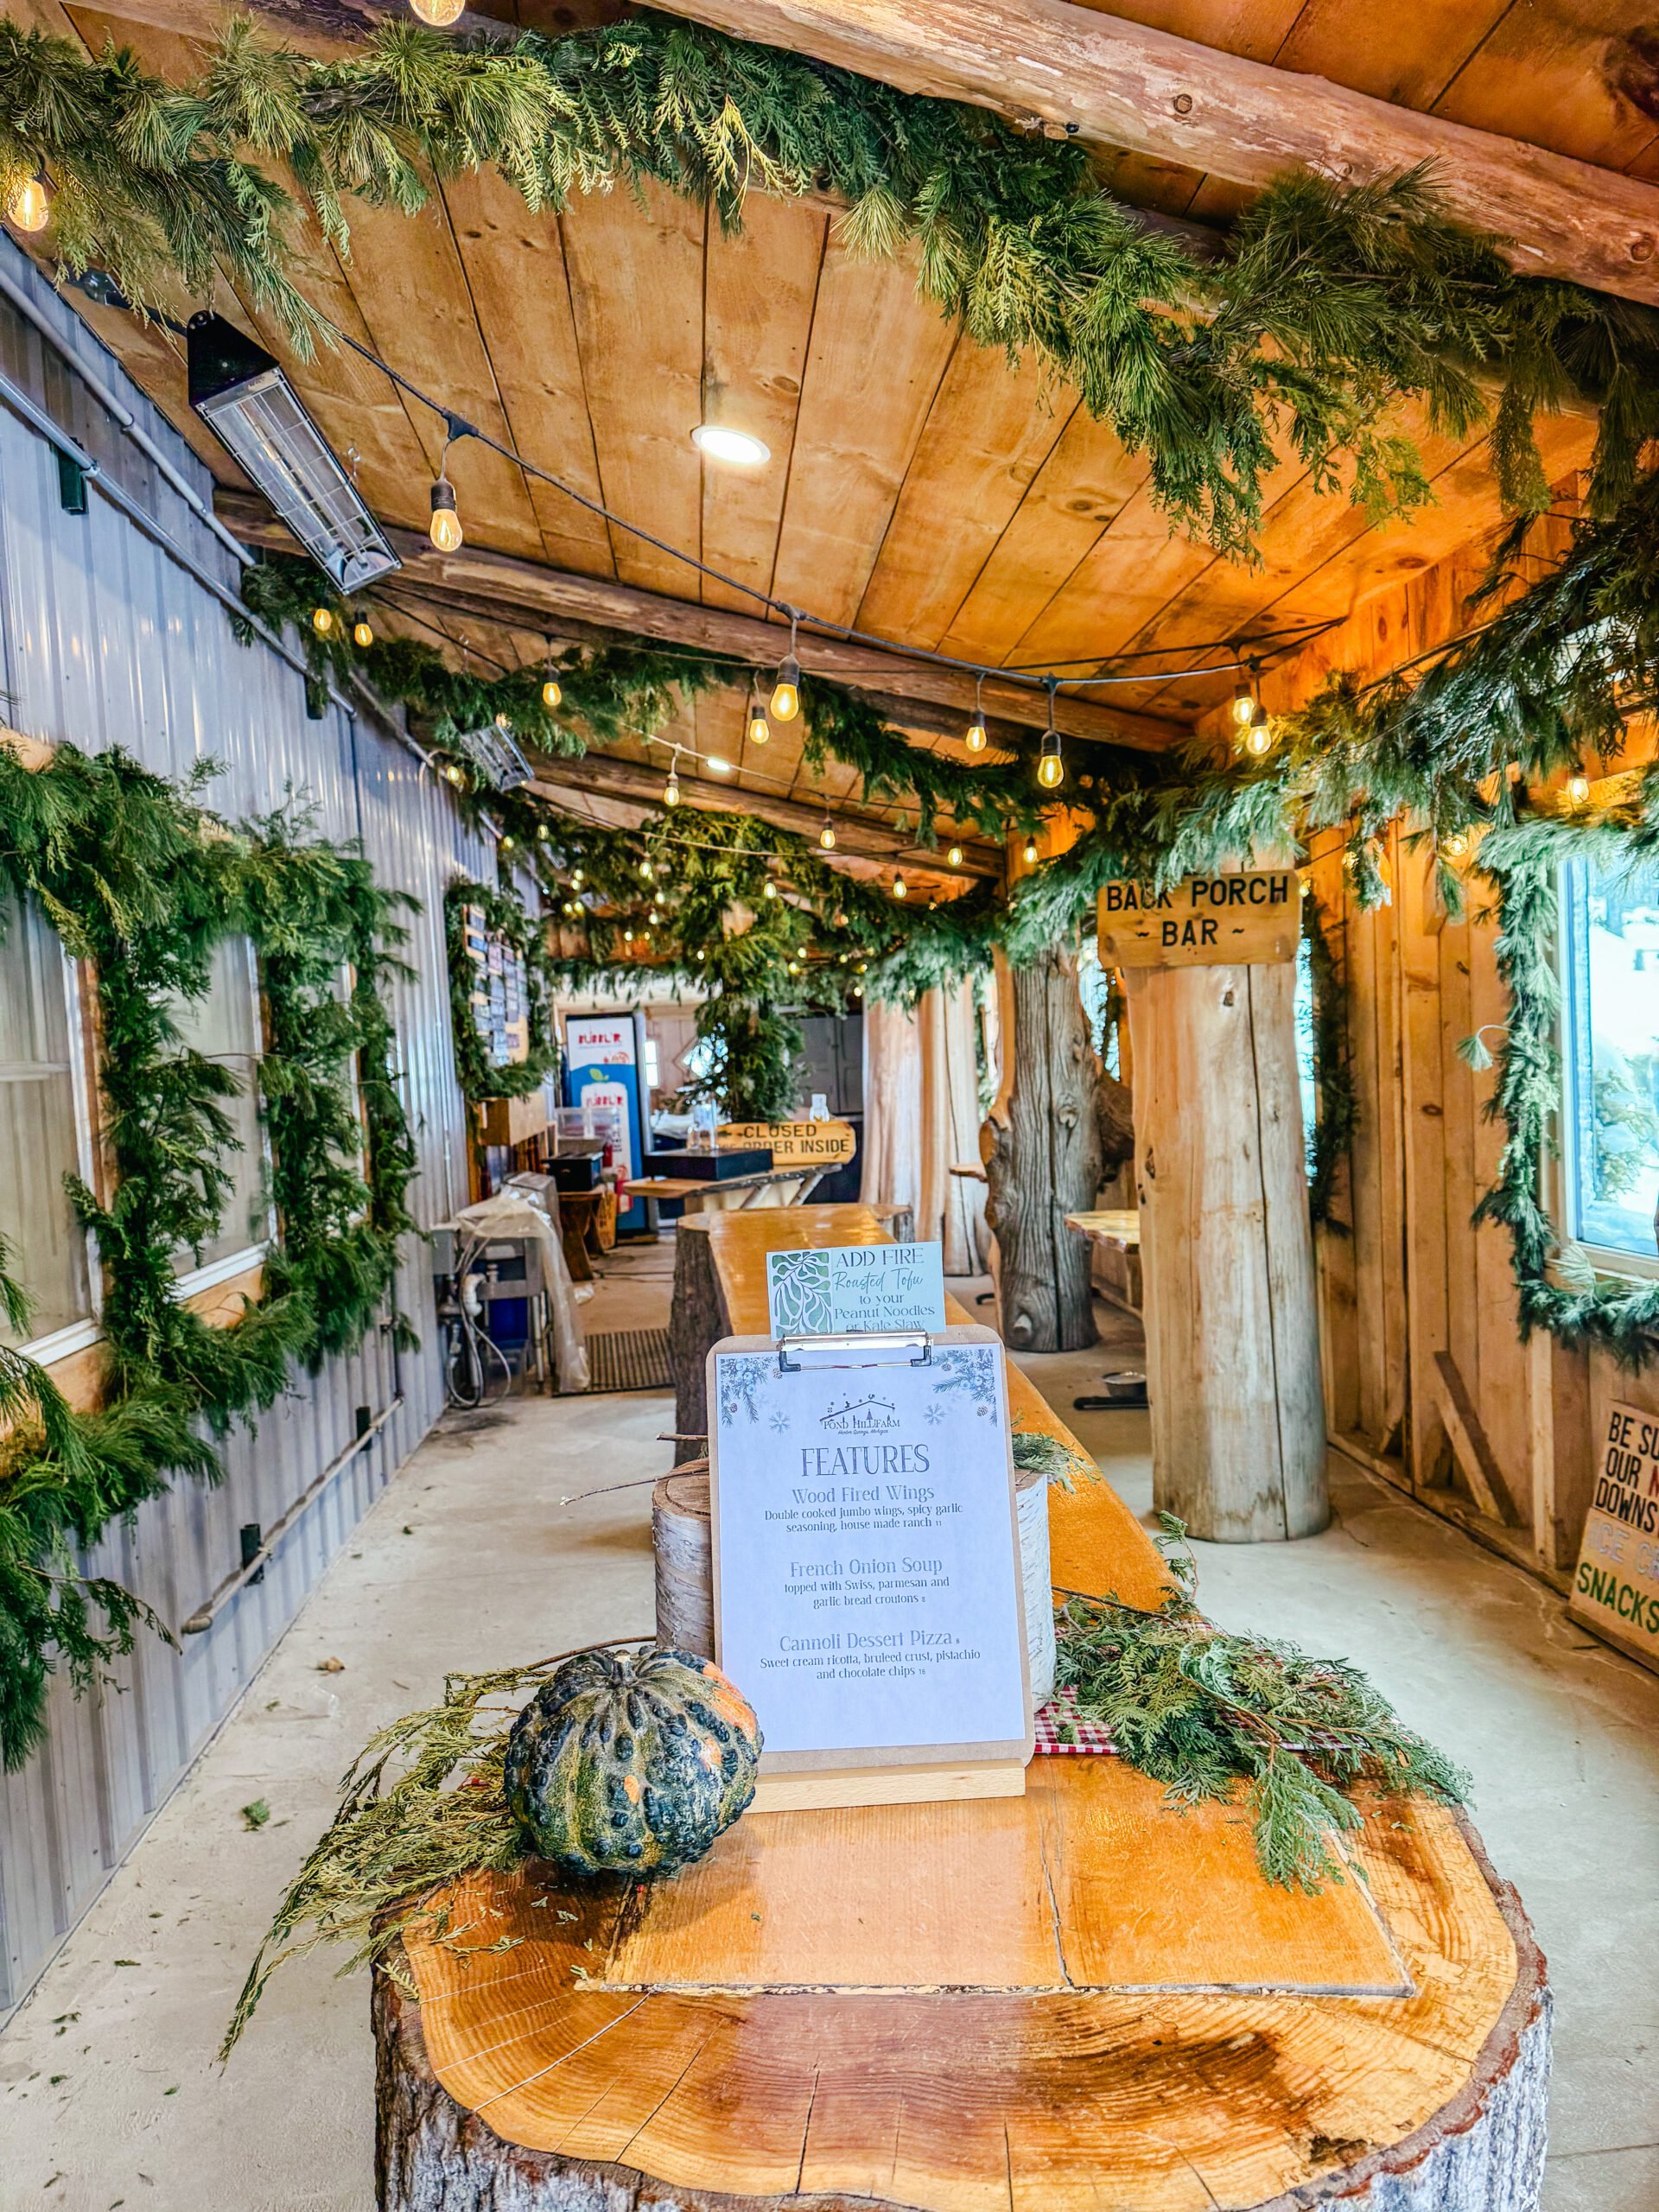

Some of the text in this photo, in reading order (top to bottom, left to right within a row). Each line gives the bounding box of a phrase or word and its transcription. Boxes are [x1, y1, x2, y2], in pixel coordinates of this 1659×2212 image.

[1192, 876, 1288, 907] PORCH
[1162, 918, 1218, 947] BAR
[744, 1124, 817, 1138] CLOSED
[801, 1139, 849, 1153] INSIDE
[836, 1248, 925, 1268] ADD FIRE
[832, 1268, 923, 1294] Roasted Tofu
[860, 1294, 904, 1306] to your
[835, 1305, 935, 1319] Peanut Noodles
[846, 1319, 925, 1332] or Kale Slaw
[823, 1420, 849, 1430] POND
[1608, 1411, 1635, 1449] BE
[800, 1444, 930, 1477] FEATURES
[1605, 1447, 1642, 1490] OUR
[792, 1484, 935, 1504] Wood Fired Wings
[765, 1503, 963, 1521] Double cooked jumbo wings, spicy garlic
[1595, 1478, 1659, 1535] DOWNS
[786, 1521, 837, 1533] seasoning,
[841, 1519, 870, 1530] house
[873, 1518, 900, 1529] made
[903, 1517, 932, 1528] ranch
[790, 1556, 943, 1578] French Onion Soup
[785, 1576, 950, 1595] topped with Swiss, parmesan and
[813, 1596, 842, 1610] garlic
[844, 1595, 872, 1605] bread
[874, 1593, 918, 1605] croutons
[1577, 1561, 1659, 1634] SNACKS
[779, 1634, 841, 1651] Cannoli
[847, 1631, 904, 1649] Dessert
[910, 1630, 952, 1646] Pizza
[760, 1649, 981, 1669] Sweet cream ricotta, bruleed crust, pistachio
[817, 1669, 836, 1680] and
[838, 1667, 886, 1679] chocolate
[888, 1666, 915, 1678] chips
